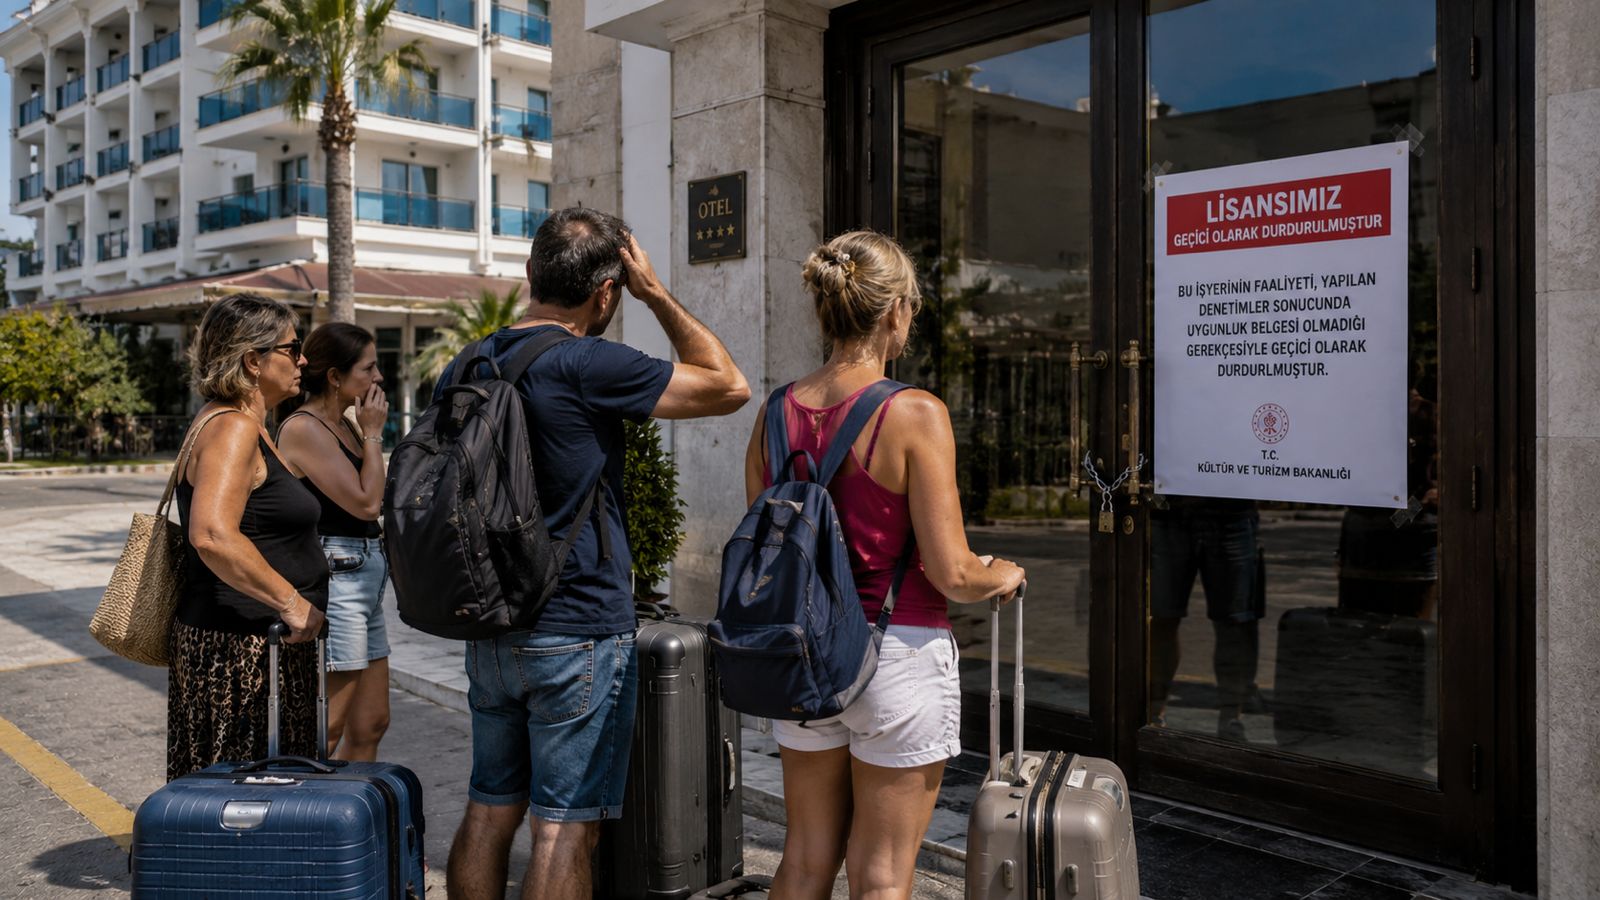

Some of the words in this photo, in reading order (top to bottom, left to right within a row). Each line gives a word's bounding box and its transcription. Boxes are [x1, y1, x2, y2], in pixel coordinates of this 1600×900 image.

[698, 198, 733, 219] OTEL
[1206, 185, 1342, 223] LİSANSIMIZ
[1174, 228, 1210, 248] GEÇİCİ
[1212, 226, 1259, 243] OLARAK
[1262, 214, 1382, 238] DURDURULMUŞTUR
[1178, 285, 1192, 297] BU
[1196, 279, 1251, 298] İŞYERİNİN
[1254, 273, 1318, 293] FAALİYETİ,
[1321, 272, 1376, 289] YAPILAN
[1199, 299, 1270, 316] DENETİMLER
[1273, 296, 1351, 313] SONUCUNDA
[1187, 322, 1248, 337] UYGUNLUK
[1251, 317, 1299, 335] BELGESİ
[1186, 341, 1268, 359] GEREKÇESİYLE
[1271, 339, 1311, 357] GEÇİCİ
[1315, 339, 1367, 354] OLARAK
[1217, 362, 1329, 379] DURDURLMUŞTUR.
[1261, 449, 1279, 461] T.C.
[1237, 464, 1249, 475] VE
